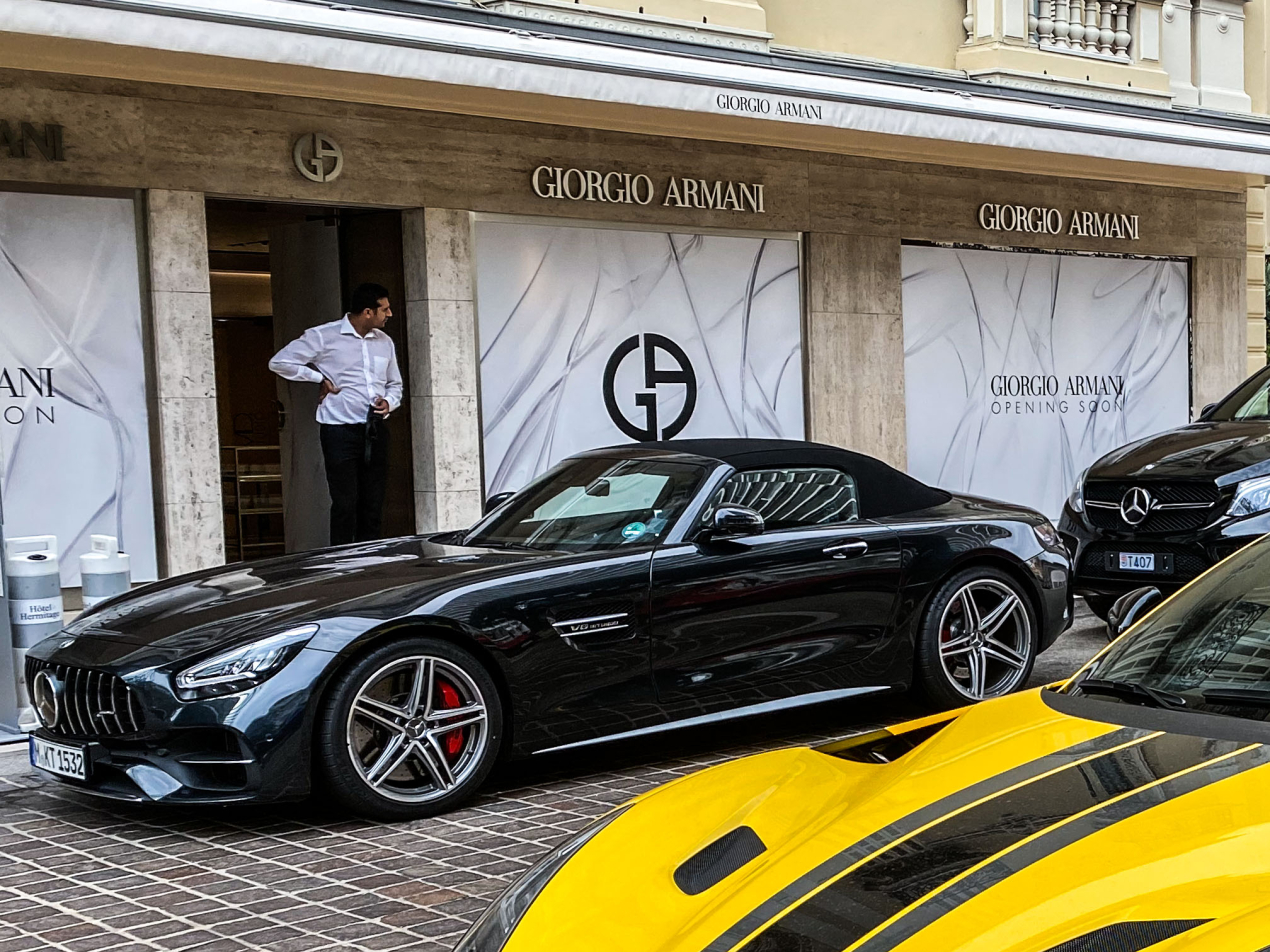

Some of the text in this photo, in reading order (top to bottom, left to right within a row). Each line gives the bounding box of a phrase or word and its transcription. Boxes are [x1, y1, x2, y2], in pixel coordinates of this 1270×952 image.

[716, 93, 822, 120] GIORGIO ARMANI
[532, 165, 766, 213] GIORGIO ARMANI
[979, 202, 1140, 240] GIORGIO ARMANI
[990, 374, 1124, 397] GIORGIO ARMANI
[990, 400, 1124, 415] OPENING SOON
[1127, 555, 1152, 569] T407
[20, 611, 60, 621] Hermitage
[29, 604, 52, 613] Hôtel
[57, 749, 84, 776] 1532
